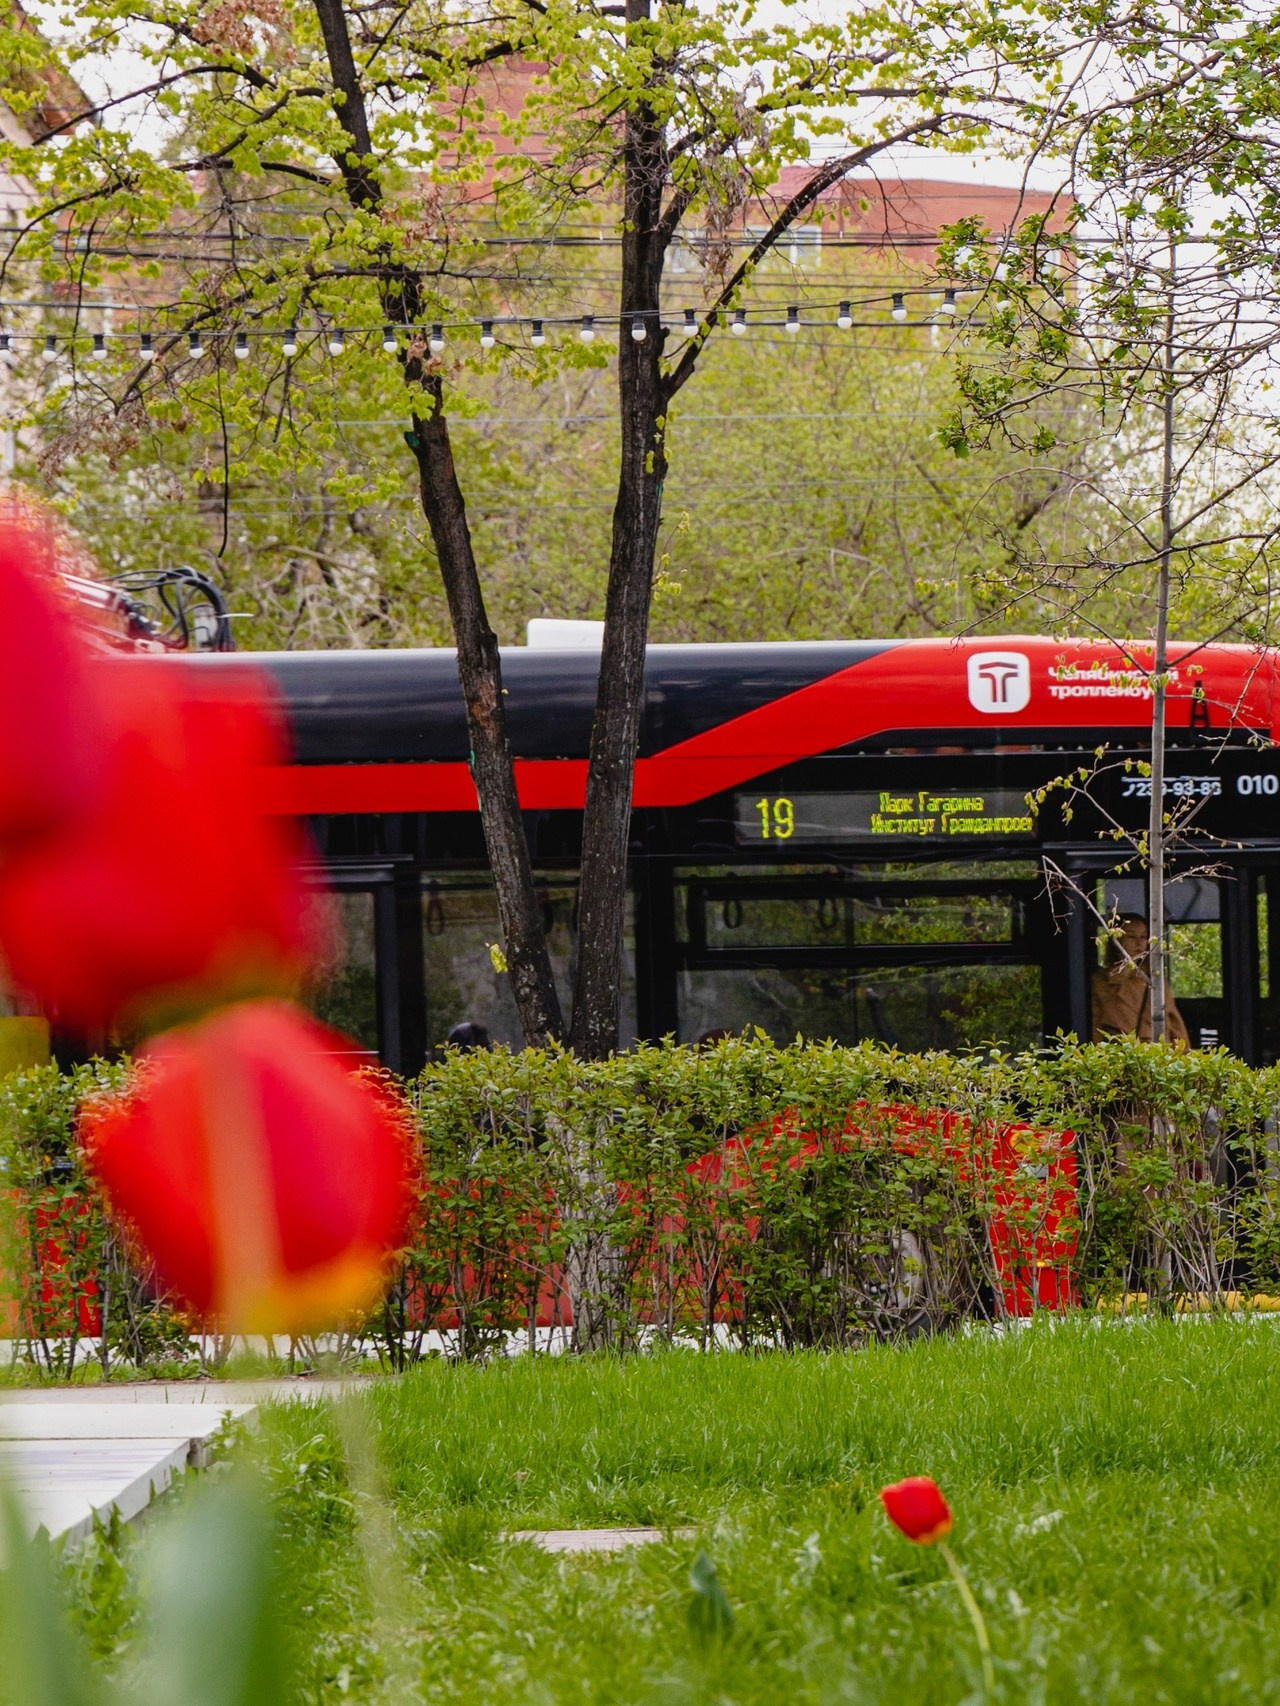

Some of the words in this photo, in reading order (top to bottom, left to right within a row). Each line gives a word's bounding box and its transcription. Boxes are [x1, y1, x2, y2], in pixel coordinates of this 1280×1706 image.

[1048, 667, 1179, 682] Челябинскй
[1048, 685, 1156, 700] троллейбу
[1237, 774, 1279, 796] 010
[880, 792, 914, 815] Парк
[918, 791, 985, 815] Гагарина
[756, 798, 794, 839] 19
[871, 813, 936, 836] Институт
